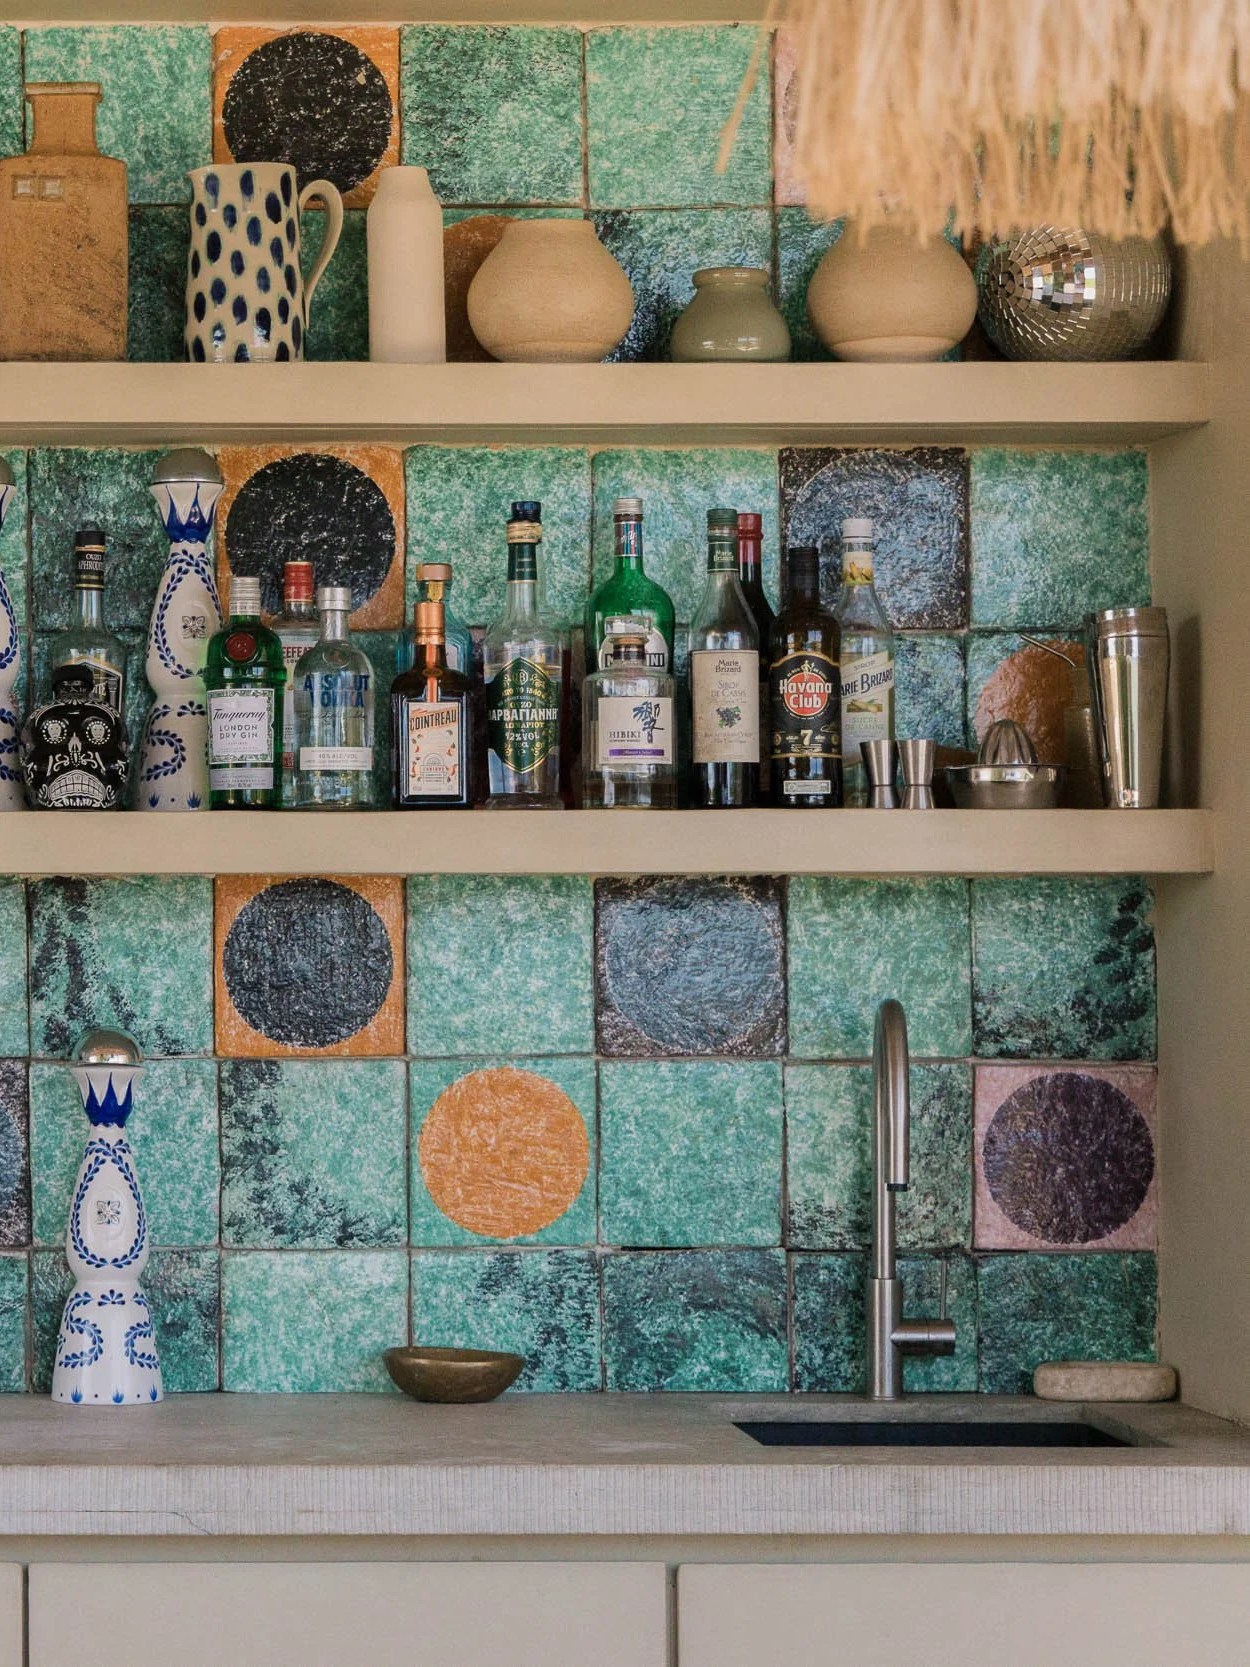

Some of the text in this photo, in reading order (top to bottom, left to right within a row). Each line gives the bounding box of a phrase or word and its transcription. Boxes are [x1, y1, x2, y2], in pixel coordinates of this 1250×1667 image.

[715, 664, 742, 673] Brizard
[718, 659, 739, 667] Marie
[779, 679, 832, 694] Havana
[790, 693, 822, 709] Club
[213, 709, 266, 722] Tanqueray
[409, 709, 457, 732] COINTREAU
[219, 724, 258, 732] LONDON
[219, 732, 237, 740] DRY
[609, 731, 641, 739] HIBIKI
[800, 729, 814, 746] 7
